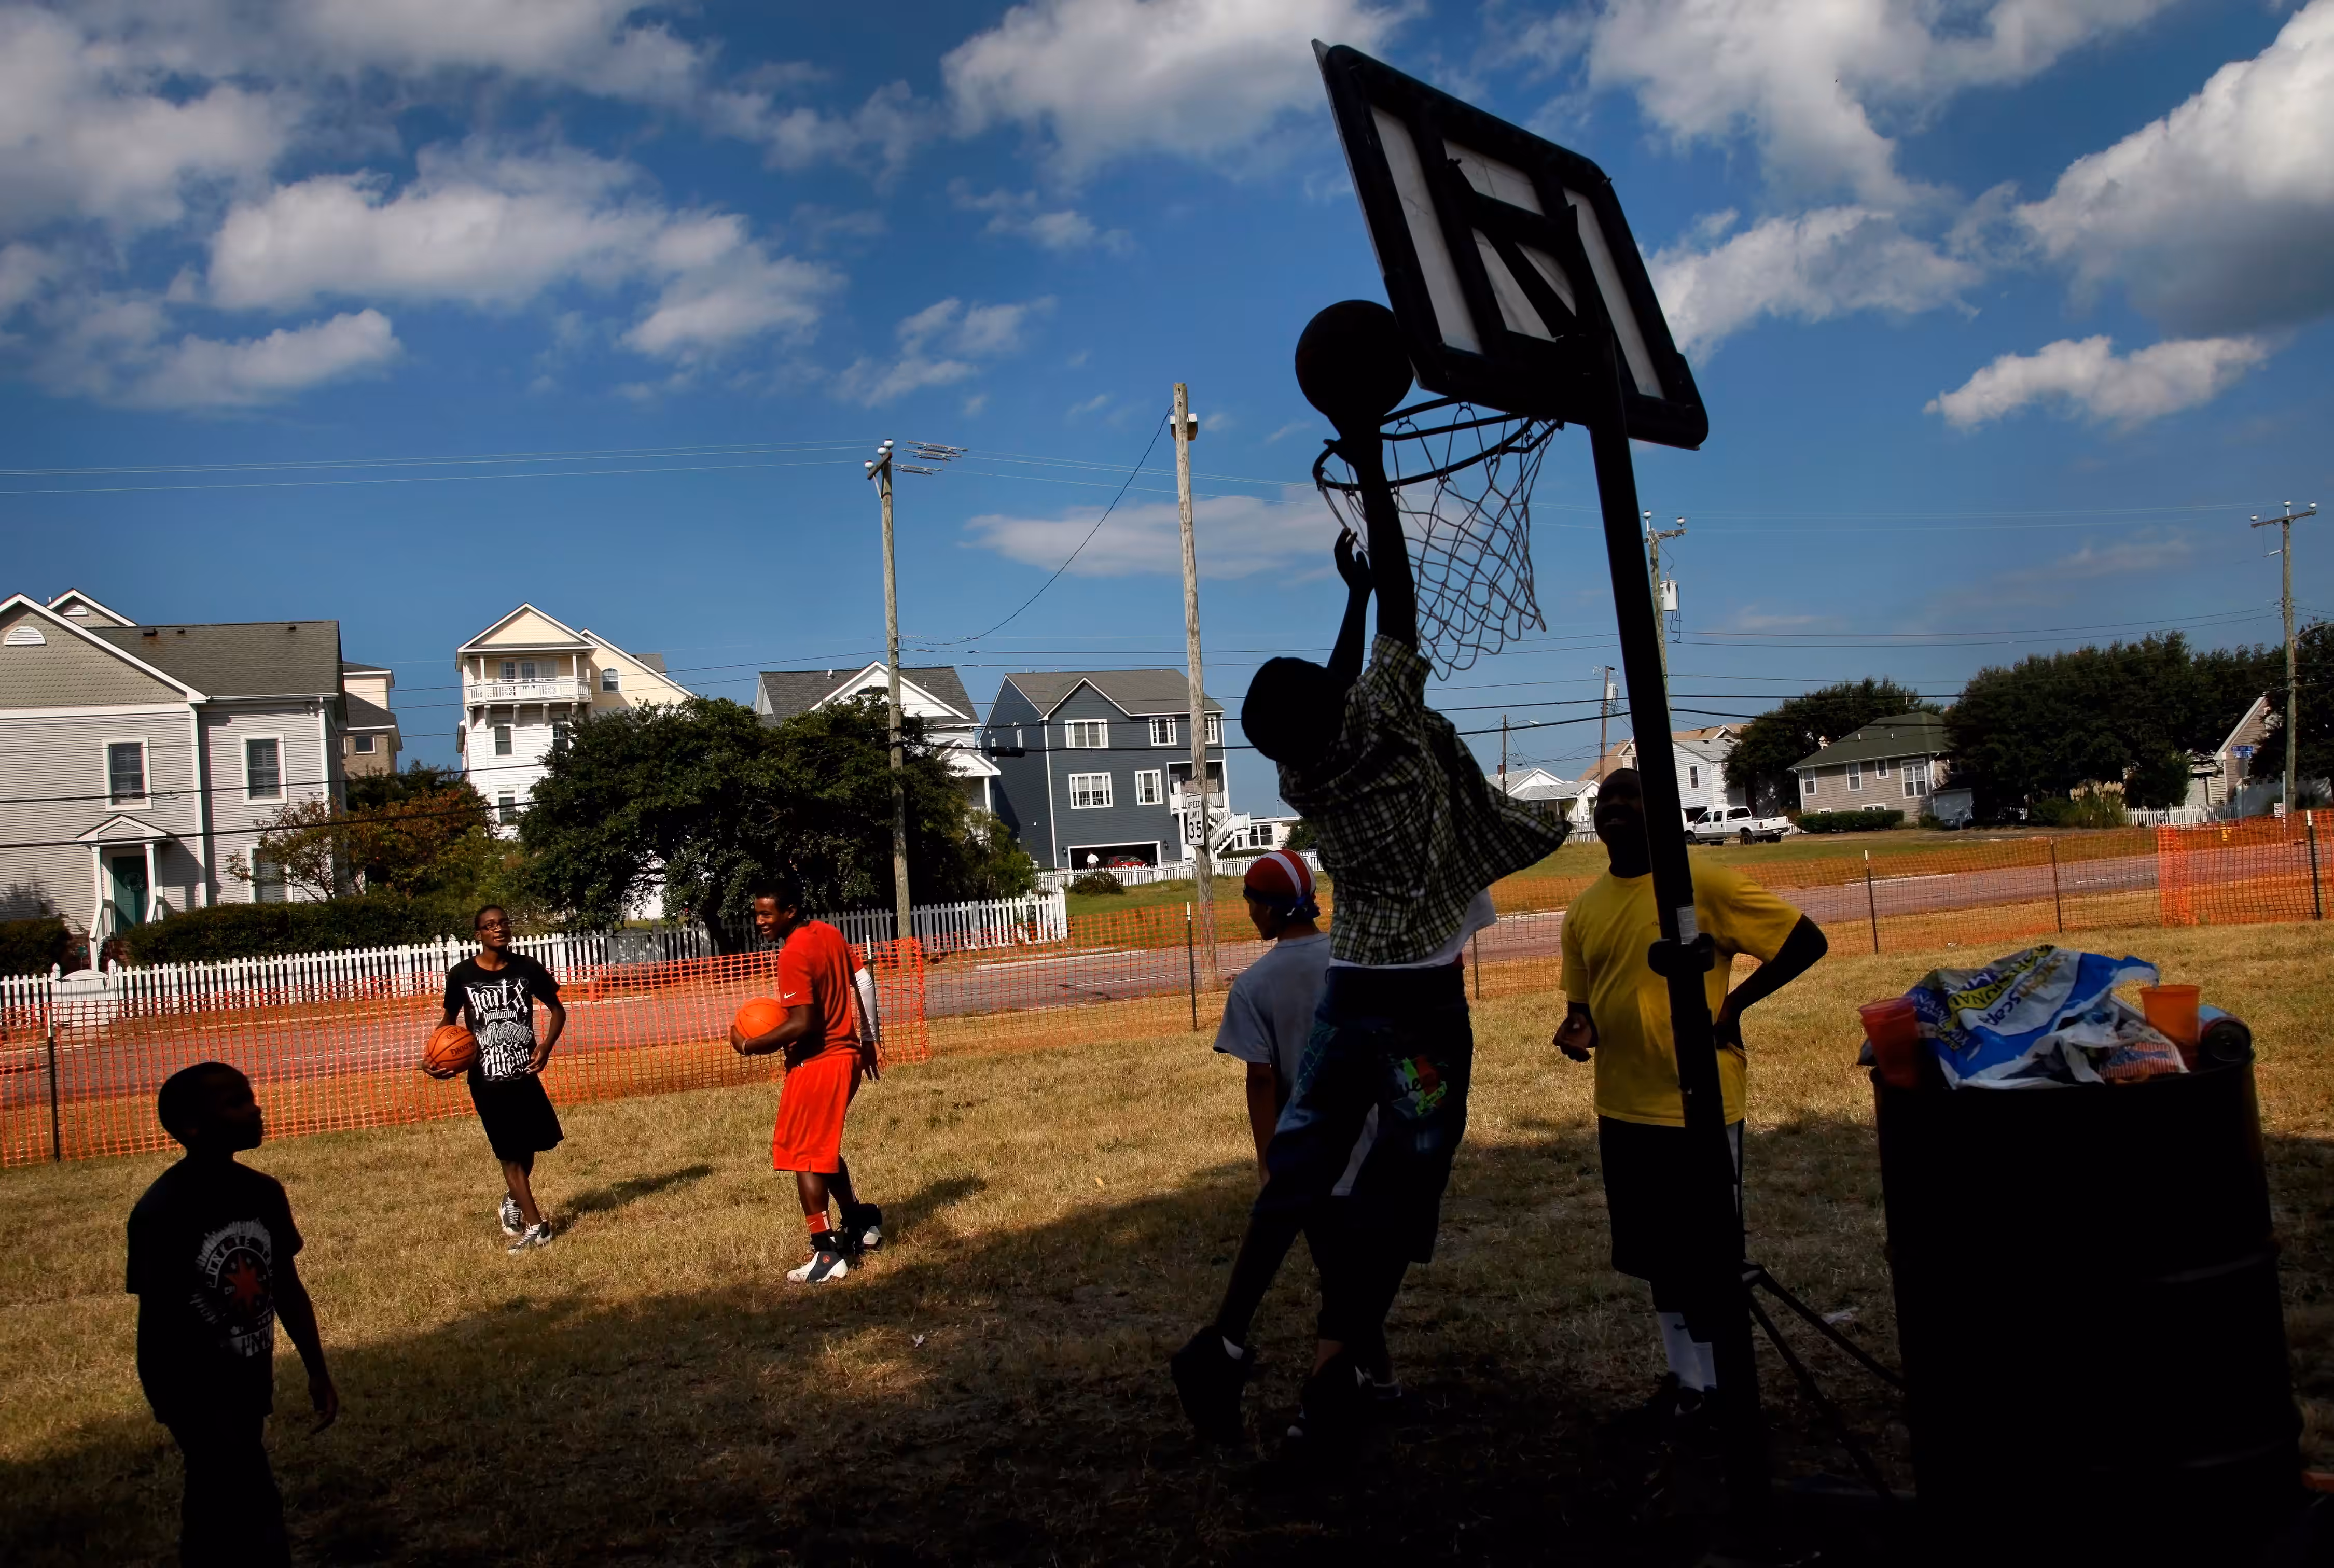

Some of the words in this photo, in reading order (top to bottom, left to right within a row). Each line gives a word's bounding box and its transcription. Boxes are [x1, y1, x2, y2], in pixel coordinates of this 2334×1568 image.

[1188, 800, 1201, 809] SPEED
[1189, 810, 1200, 819] LIMIT
[1189, 821, 1202, 839] 35
